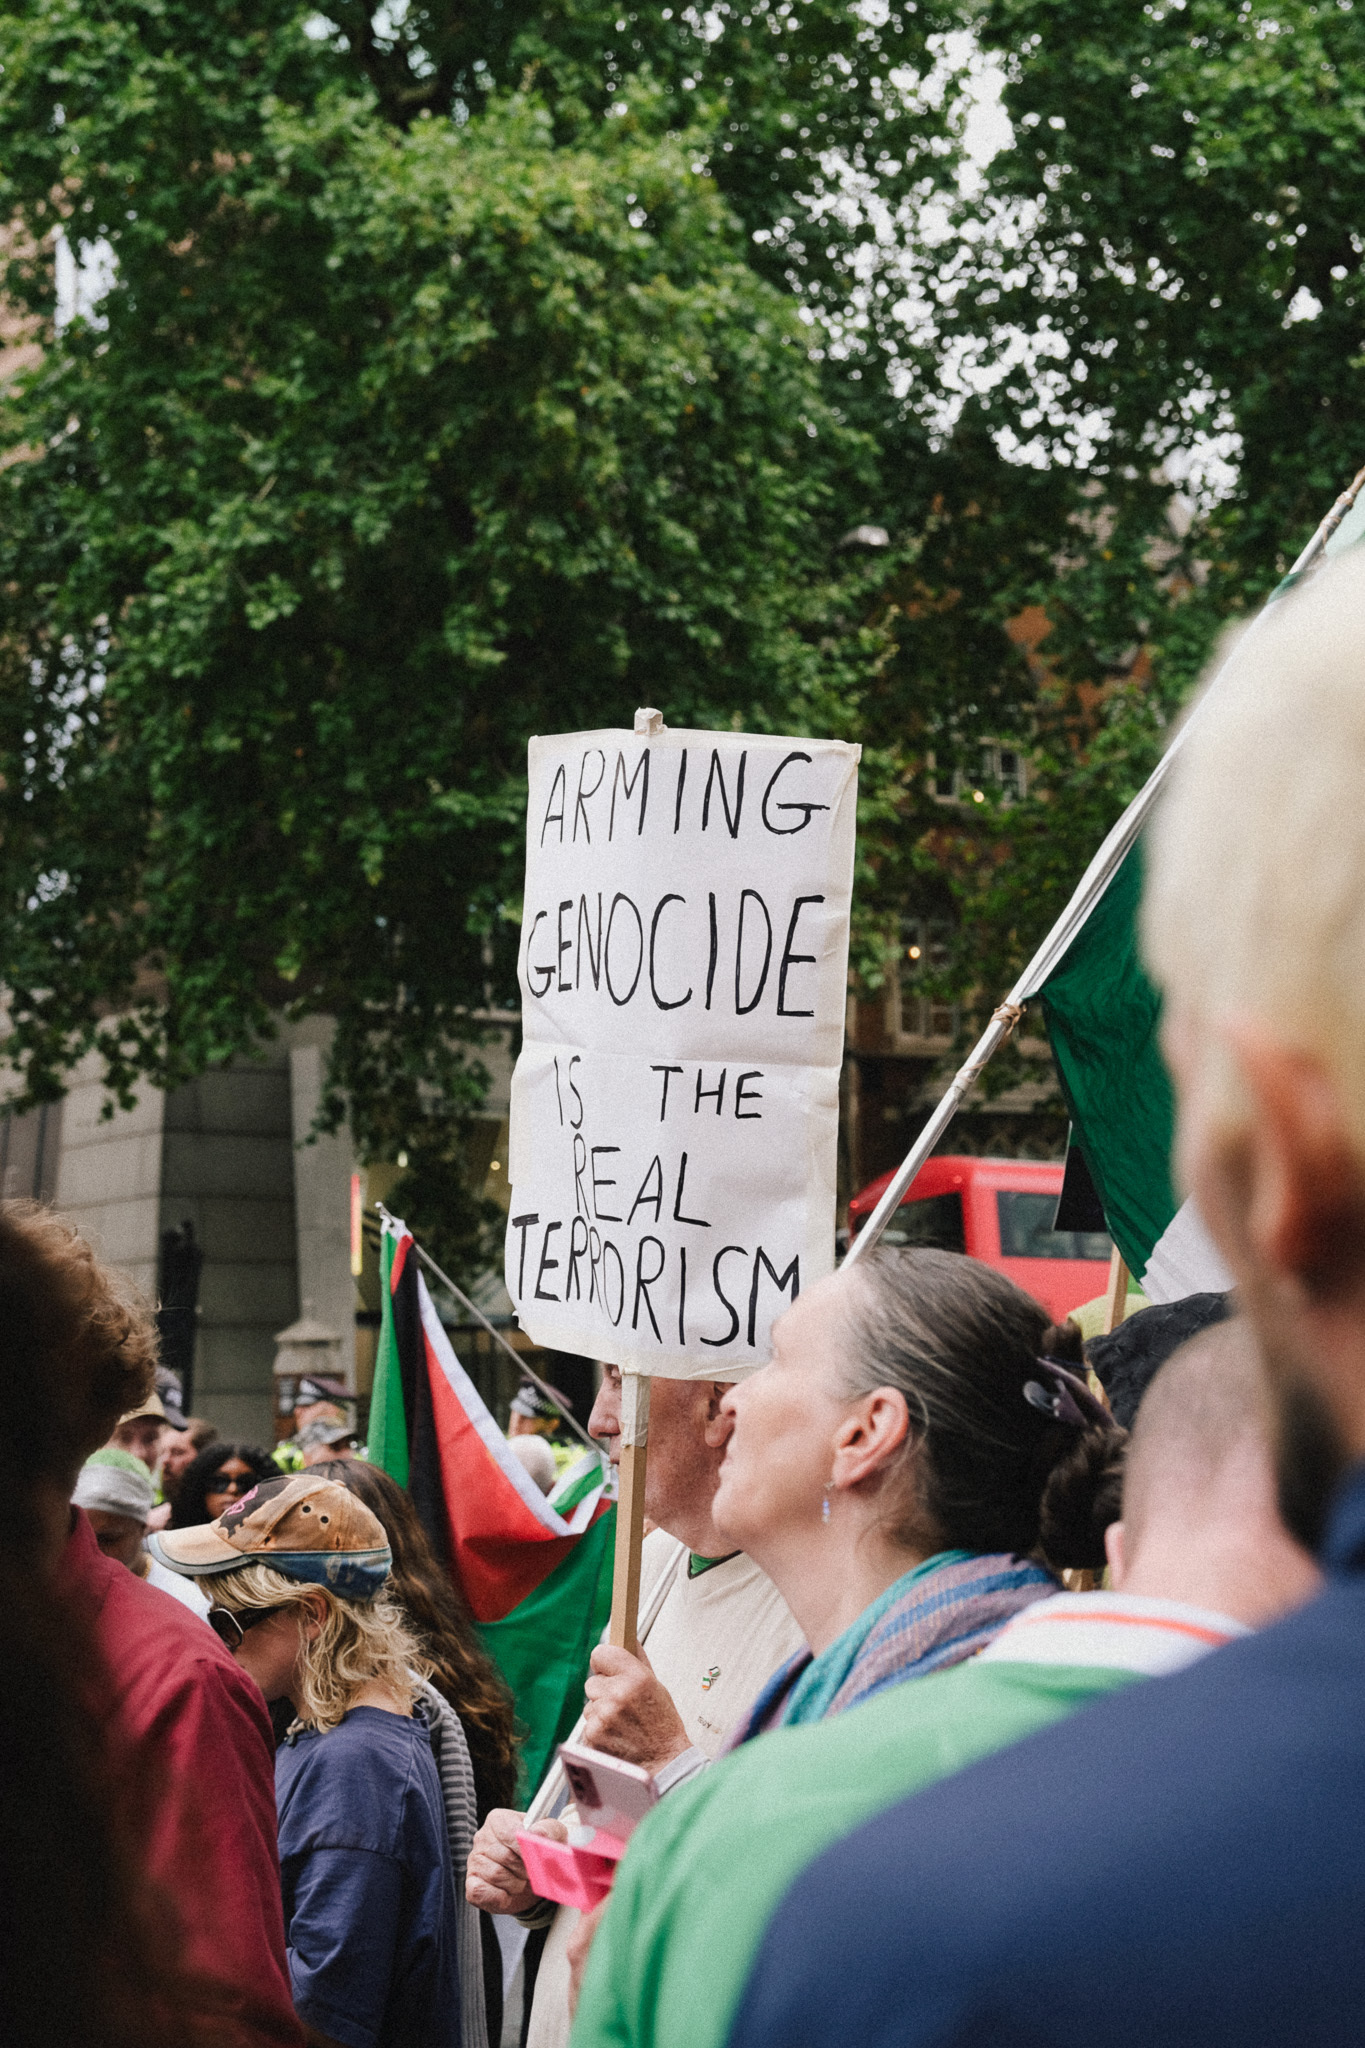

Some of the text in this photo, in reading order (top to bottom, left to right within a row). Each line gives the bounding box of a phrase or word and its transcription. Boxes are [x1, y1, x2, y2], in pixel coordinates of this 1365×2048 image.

[541, 749, 831, 847] ARMING
[526, 889, 826, 1018] GENOCIDE
[553, 1055, 764, 1130] IS THE
[572, 1133, 712, 1229] REAL
[512, 1214, 800, 1347] TERRORISM
